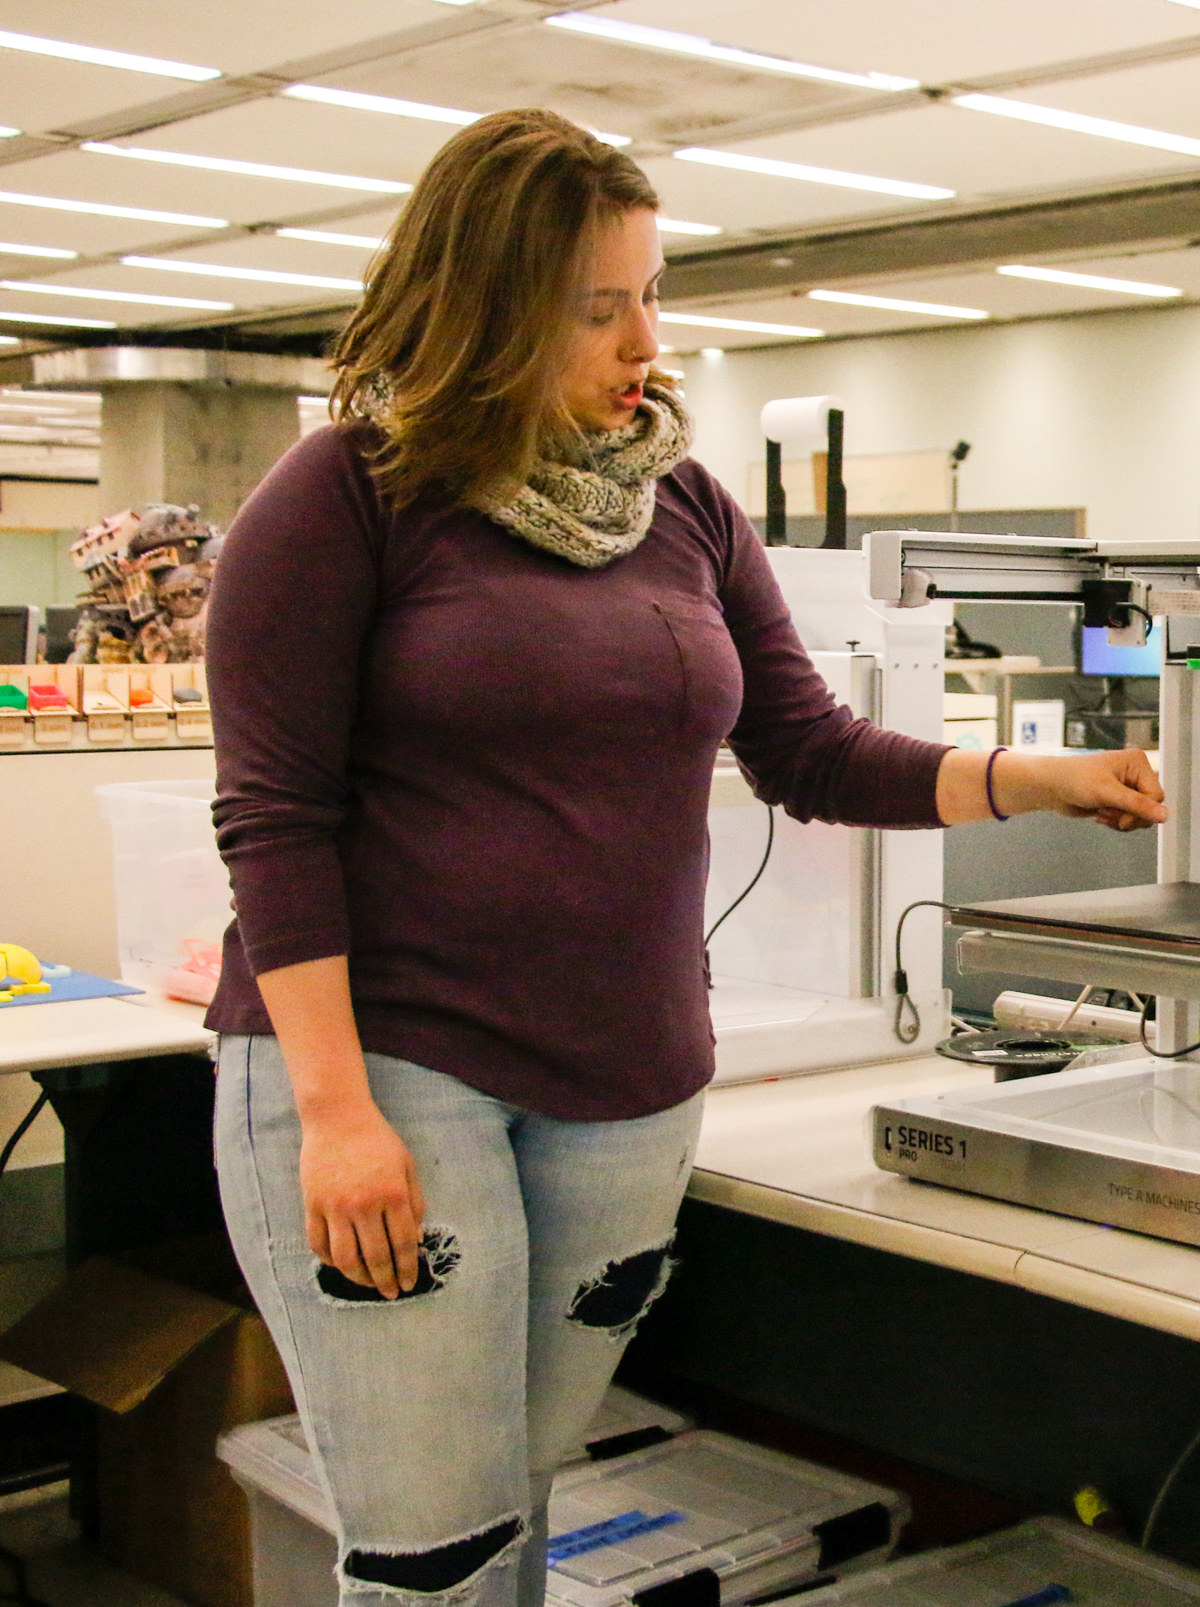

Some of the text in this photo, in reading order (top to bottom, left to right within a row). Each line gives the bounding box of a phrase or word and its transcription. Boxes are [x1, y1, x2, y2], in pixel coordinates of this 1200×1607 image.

[898, 1126, 967, 1158] SERIES 1
[899, 1148, 918, 1162] PRO
[1108, 1183, 1200, 1215] TYPE A MACHINES
